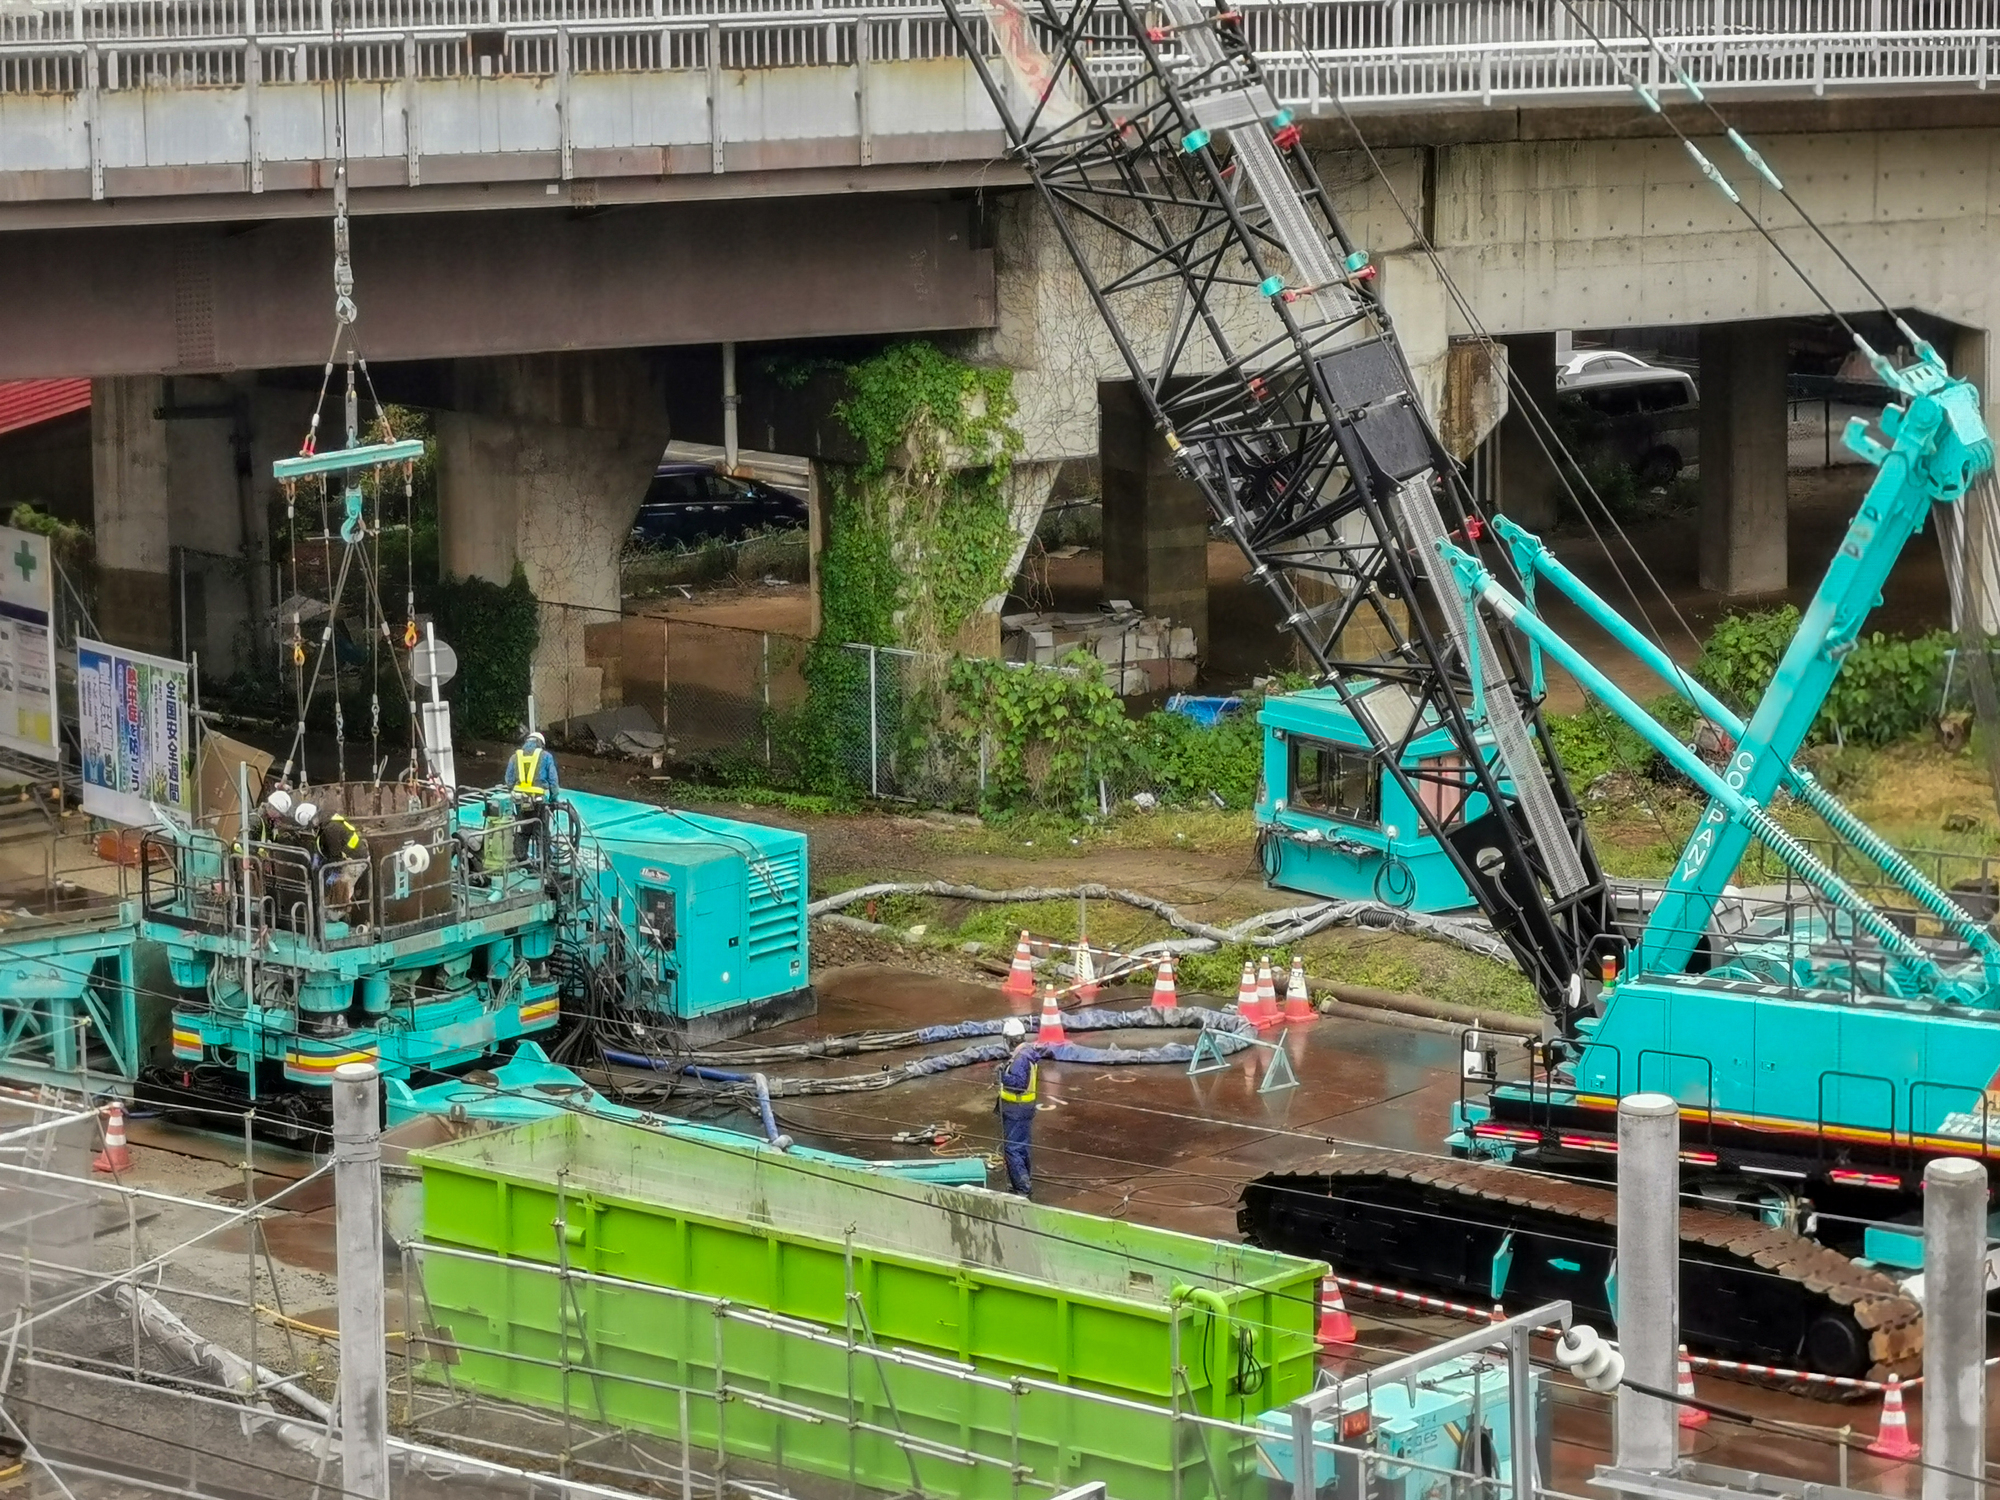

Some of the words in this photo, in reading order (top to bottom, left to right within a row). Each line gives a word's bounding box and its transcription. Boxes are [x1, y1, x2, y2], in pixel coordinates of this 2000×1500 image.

[166, 679, 179, 802] 全国安全週間
[1682, 751, 1755, 882] COPANY
